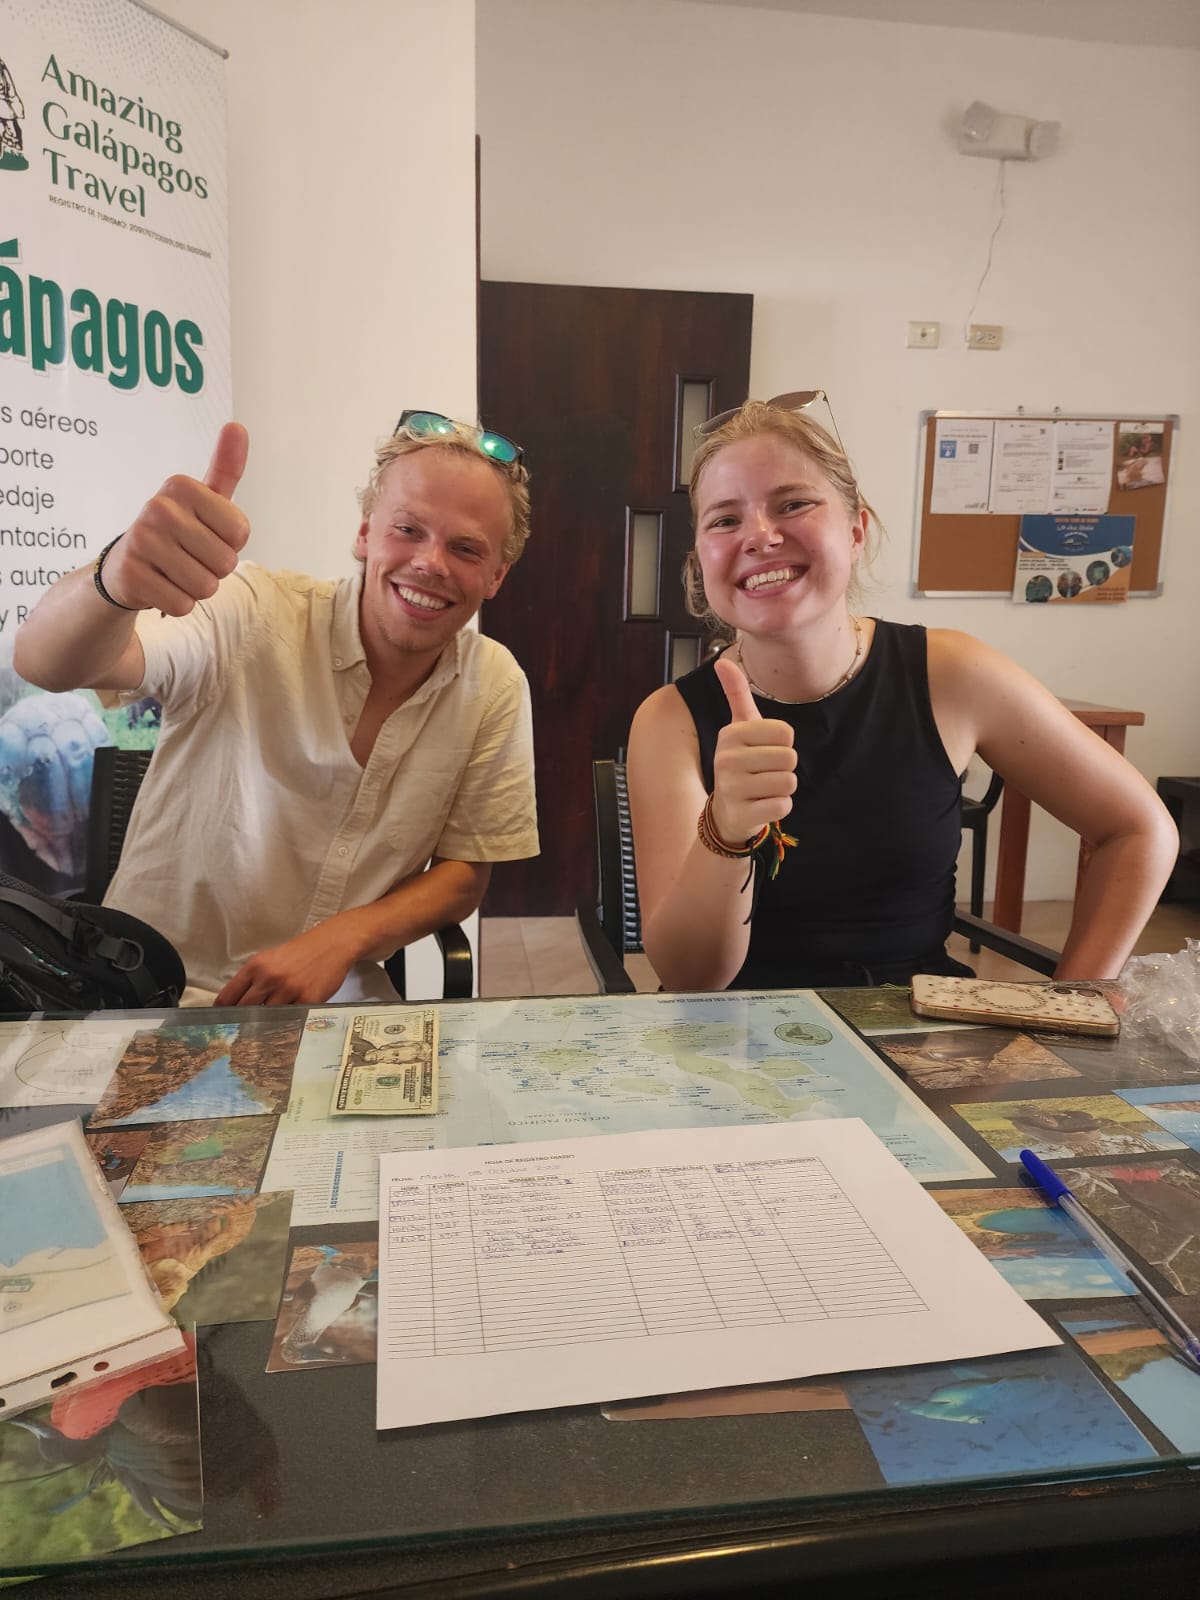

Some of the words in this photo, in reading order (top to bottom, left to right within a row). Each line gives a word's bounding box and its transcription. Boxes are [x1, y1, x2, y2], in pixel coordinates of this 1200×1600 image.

[41, 54, 183, 154] Amazing
[42, 102, 209, 200] Galápagos
[43, 148, 145, 217] Travel
[48, 194, 87, 213] REGISTRO
[88, 207, 96, 217] DE
[20, 406, 98, 437] aéreos
[0, 526, 87, 550] ntación
[10, 565, 75, 587] auto
